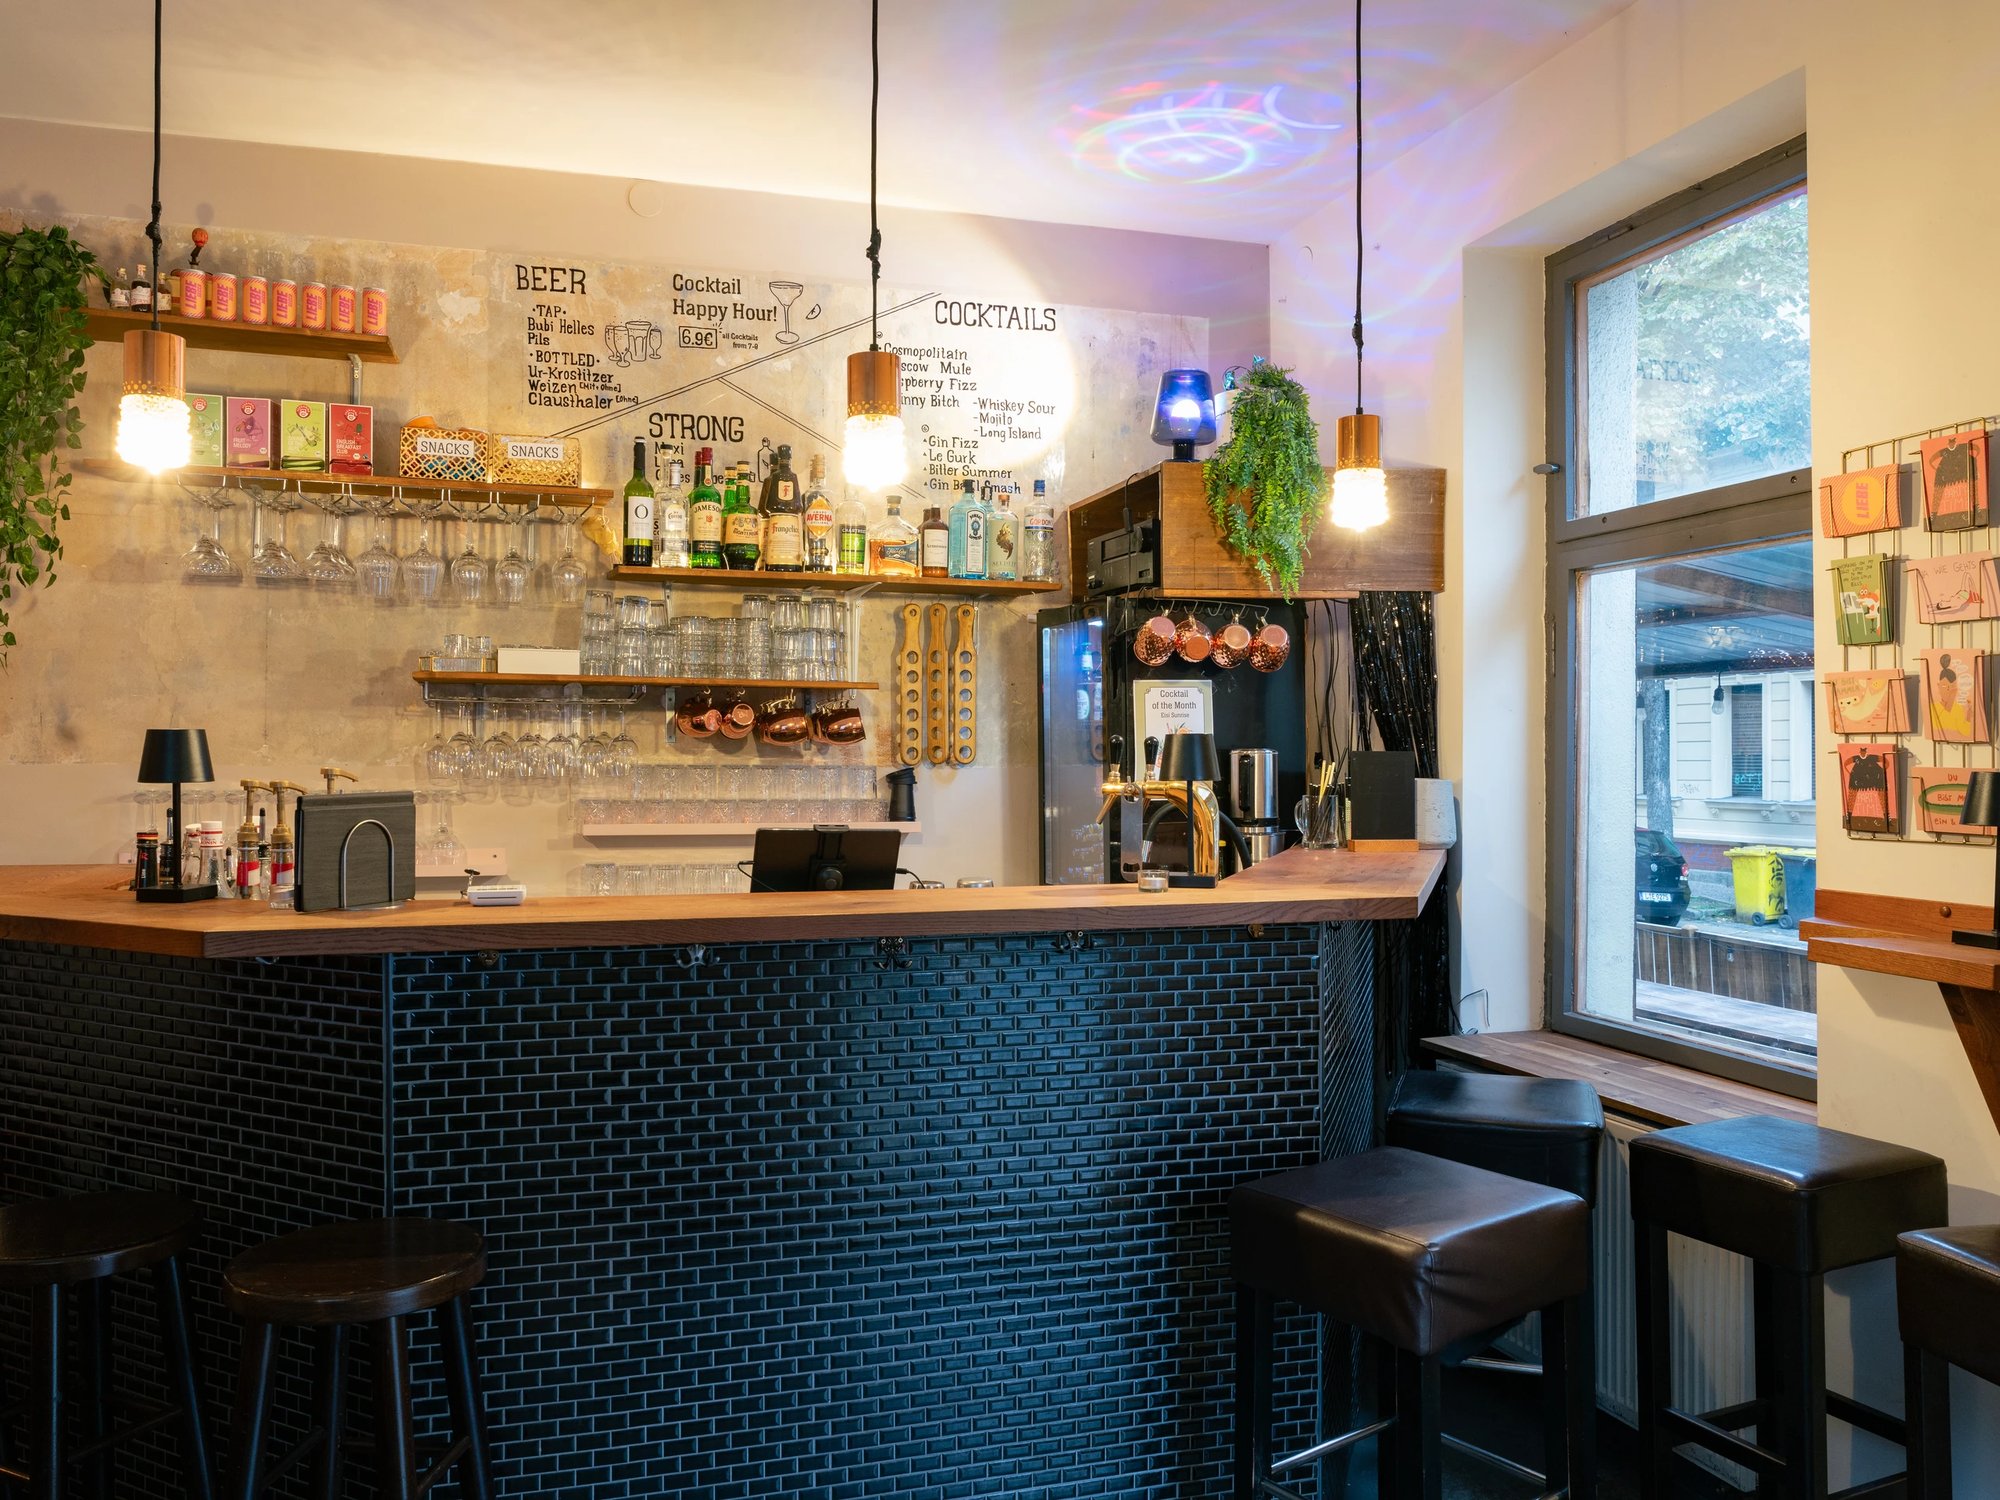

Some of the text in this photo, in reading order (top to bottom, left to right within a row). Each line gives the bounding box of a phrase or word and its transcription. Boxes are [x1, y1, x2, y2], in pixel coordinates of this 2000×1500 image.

[515, 264, 587, 295] BEER
[672, 273, 742, 296] Cocktail
[185, 280, 197, 309] LIEBE
[217, 283, 228, 313] LIEBE
[250, 286, 261, 315] LIEBE
[276, 290, 288, 319] LIEBE
[306, 293, 318, 321] LIEBE
[339, 295, 350, 324] LIEBE
[367, 298, 379, 326] LIEBE
[672, 299, 778, 322] Happy Hour!
[935, 300, 1057, 332] COCKTAILS
[527, 316, 595, 336] Bubi Helles
[528, 332, 550, 346] Pils
[681, 328, 714, 348] 6.9€
[535, 350, 595, 368] BOTTLED
[528, 365, 614, 384] Ur-Krostitzer
[901, 361, 972, 376] scow Mule
[528, 379, 577, 394] Weizen
[901, 376, 977, 393] pberry Fizz
[528, 392, 613, 409] Clausthaler
[930, 395, 960, 408] Bitch
[1028, 400, 1056, 415] Sour
[649, 412, 745, 443] STRONG
[1008, 427, 1042, 440] Island
[420, 441, 470, 456] SNACKS
[655, 441, 684, 455] Mxi
[928, 435, 979, 449] Gin Fizz
[511, 444, 559, 459] SNACKS
[929, 449, 977, 465] Le Gurk
[962, 464, 1013, 479] Summer
[929, 478, 949, 491] Gin
[693, 504, 720, 513] JAMESO
[1856, 482, 1870, 519] LIEBE
[806, 513, 833, 521] AVERNA
[1160, 689, 1189, 698] Cocktail
[1152, 701, 1197, 710] of the Month
